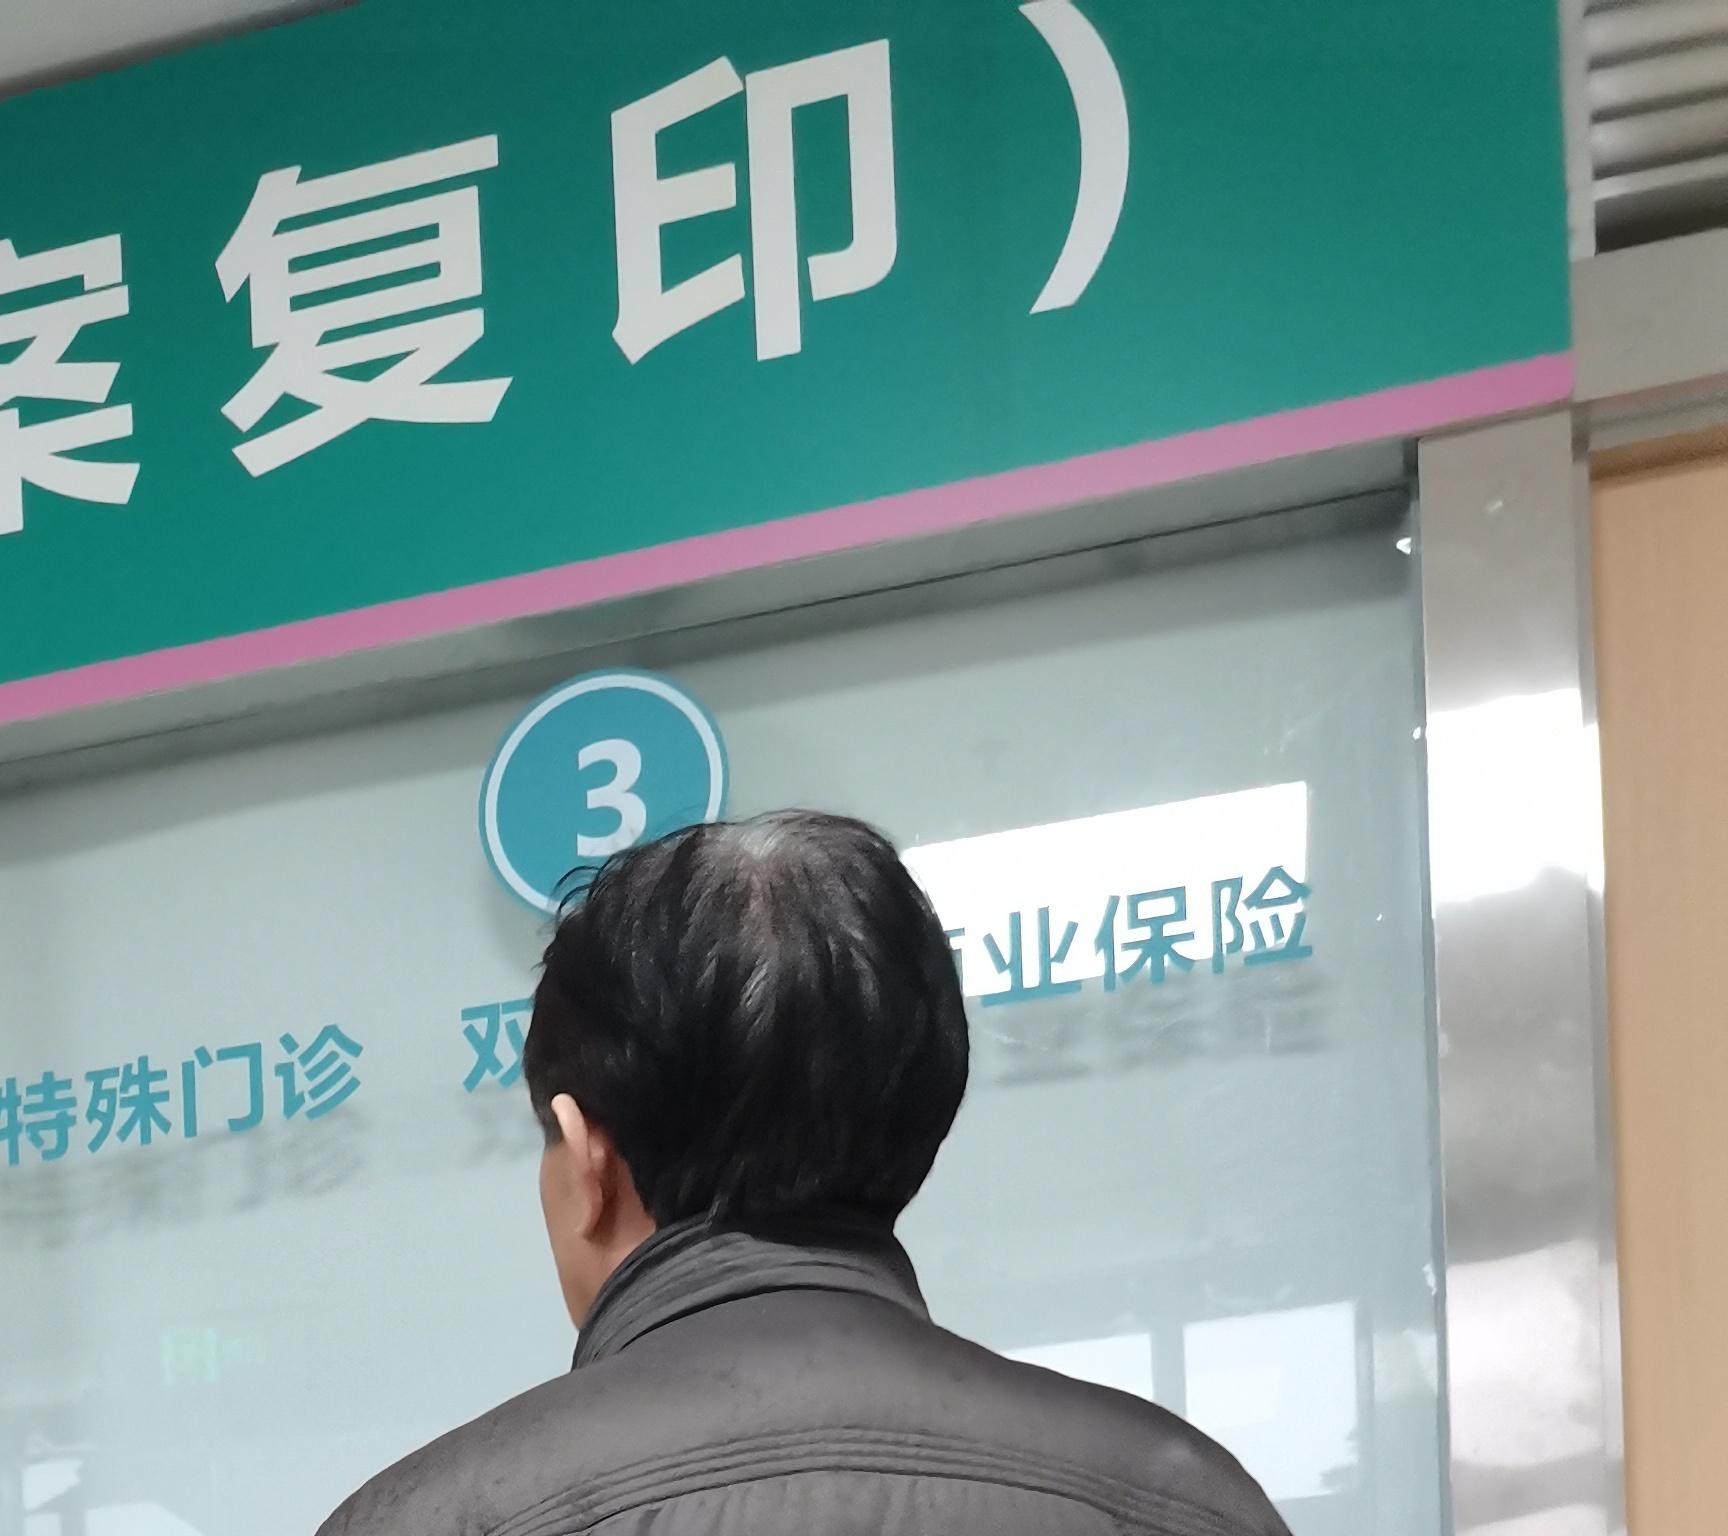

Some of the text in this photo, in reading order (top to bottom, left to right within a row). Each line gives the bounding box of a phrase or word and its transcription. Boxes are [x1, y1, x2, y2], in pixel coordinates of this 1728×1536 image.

[576, 738, 647, 857] 3
[944, 865, 1313, 1008] 业保险
